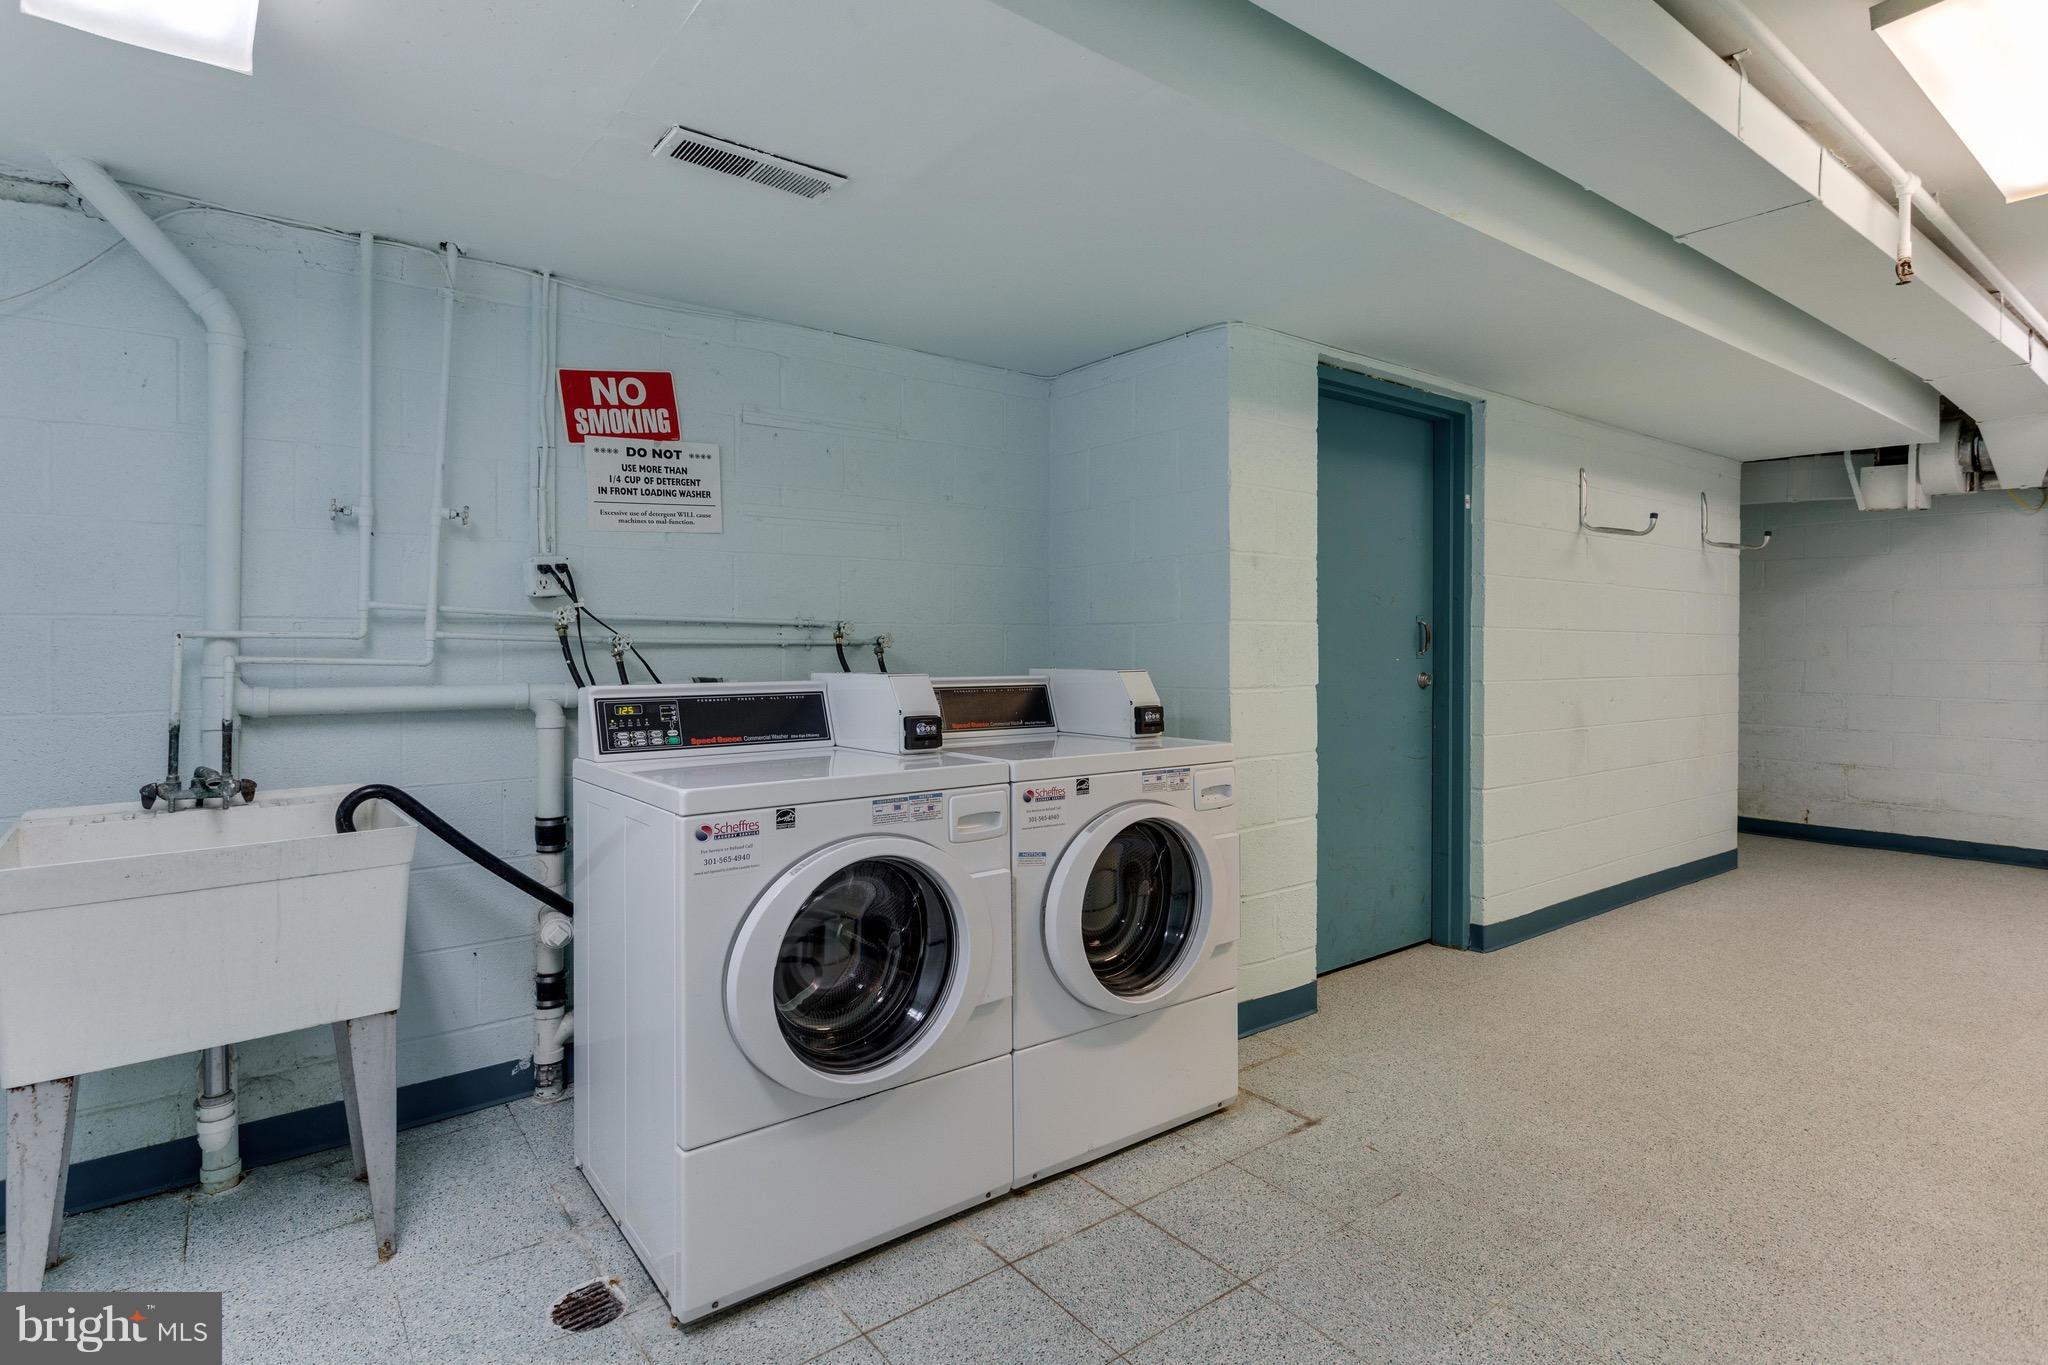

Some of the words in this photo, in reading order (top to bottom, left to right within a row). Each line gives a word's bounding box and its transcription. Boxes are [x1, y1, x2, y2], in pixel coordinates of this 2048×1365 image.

[590, 376, 647, 406] NO
[573, 407, 671, 434] SMOKING
[626, 446, 647, 458] DO
[652, 449, 682, 460] NOT
[621, 463, 637, 472] USE
[639, 464, 662, 474] MORE
[664, 466, 688, 475] THAN
[609, 474, 621, 484] 1/4
[624, 475, 641, 484] CUP
[644, 476, 655, 485] OF
[656, 477, 701, 487] DETERGENT
[597, 486, 608, 494] IN
[610, 487, 638, 496] FRONT
[640, 488, 677, 498] LOADING
[678, 490, 712, 499] WASHER
[648, 511, 676, 519] detergent
[690, 737, 717, 745] Speed
[718, 735, 743, 743] Queen
[743, 733, 771, 742] Commercial
[1035, 787, 1066, 797] Scheffres
[714, 820, 760, 834] Scheffres
[703, 853, 751, 866] 301-565-4940
